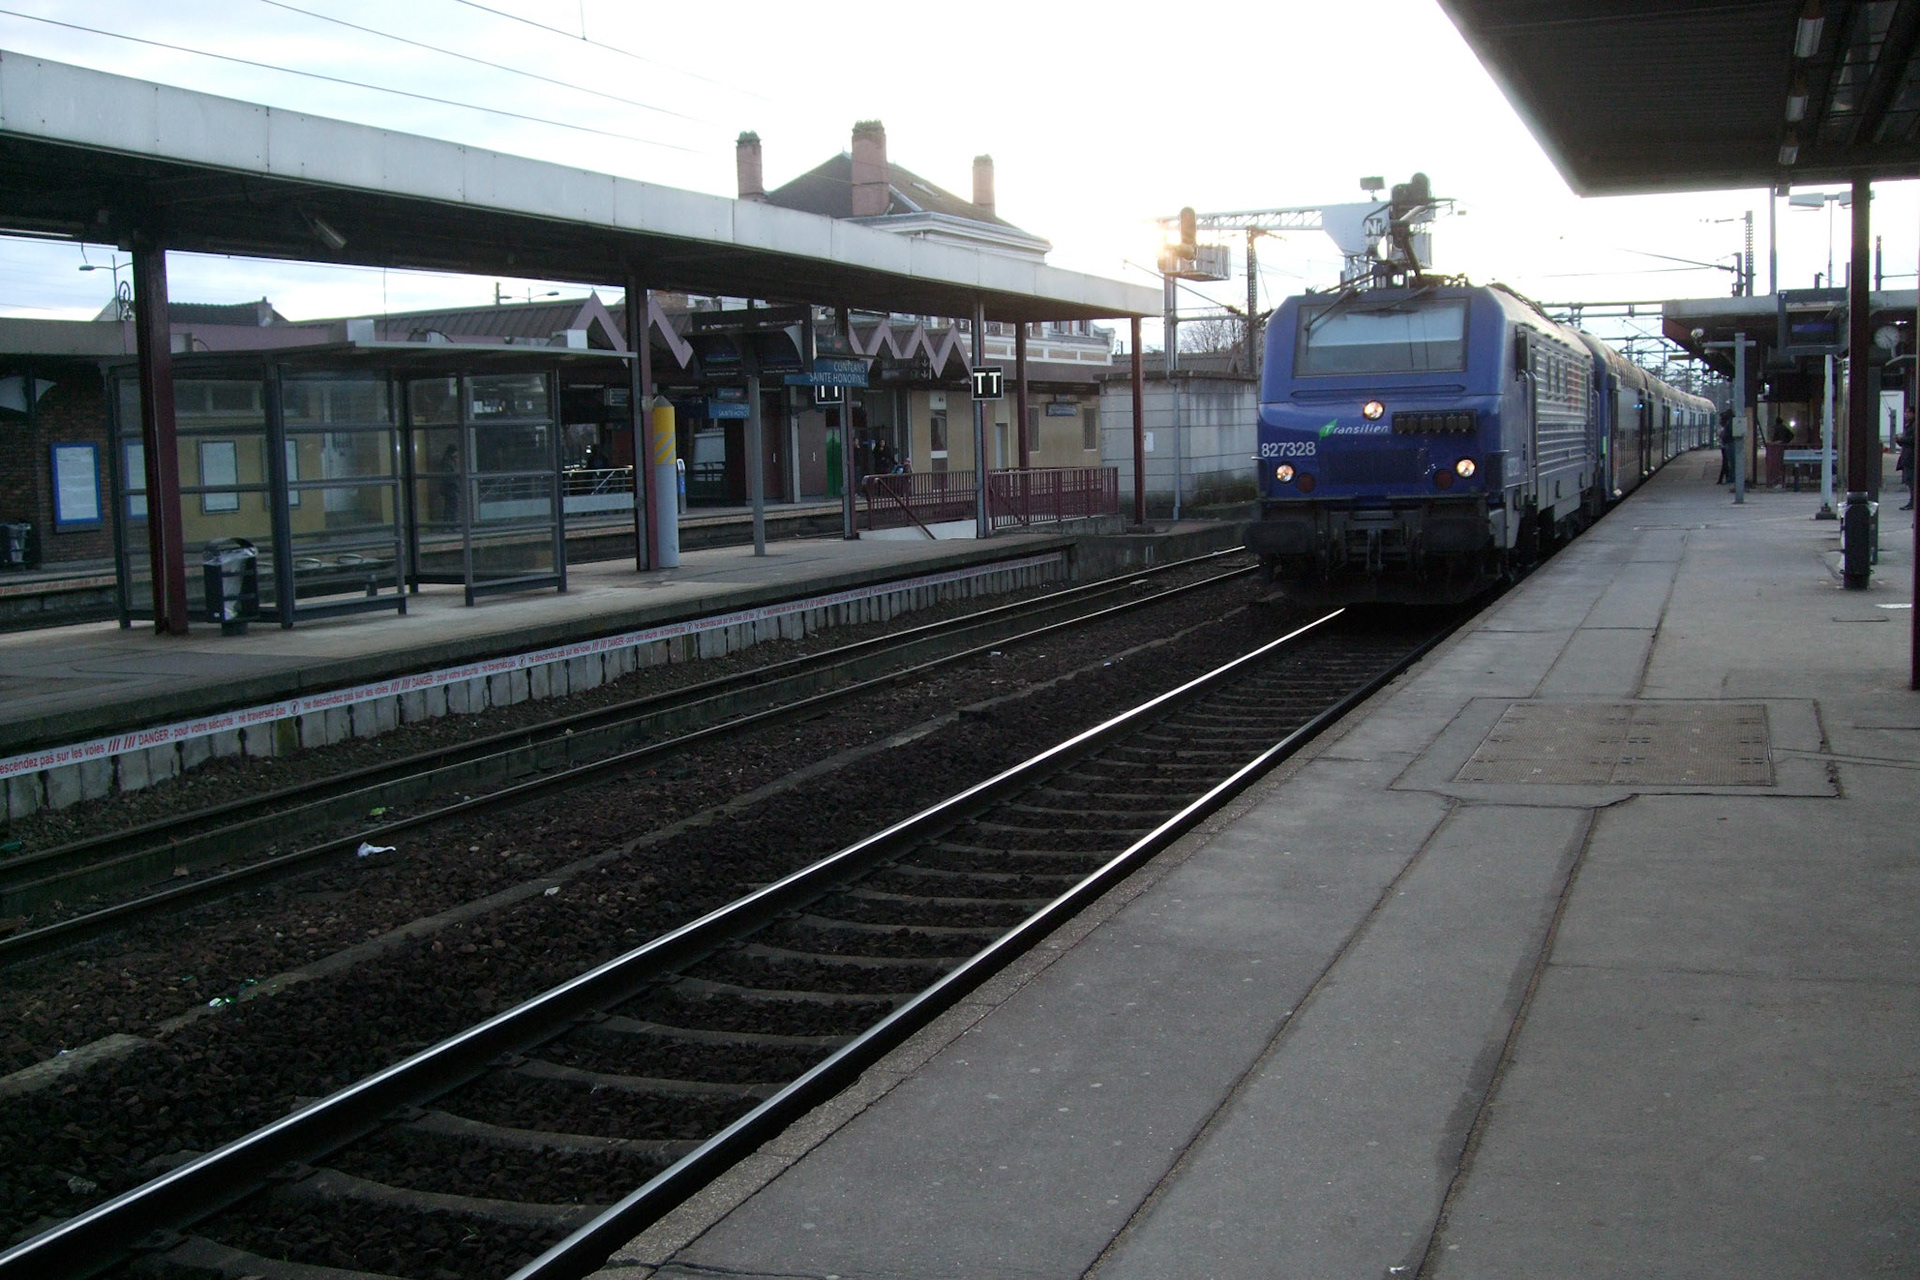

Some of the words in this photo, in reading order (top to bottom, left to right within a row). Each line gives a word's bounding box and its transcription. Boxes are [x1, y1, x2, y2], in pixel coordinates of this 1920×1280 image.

[973, 372, 1001, 394] TT
[1325, 424, 1389, 435] Transilien
[1261, 441, 1316, 457] 827328
[0, 757, 38, 774] escendez
[40, 753, 55, 768] pas
[56, 751, 70, 763] sur
[71, 747, 83, 759] les
[85, 743, 105, 756] voies
[138, 728, 169, 746] DANGER
[174, 725, 189, 740] pour
[190, 721, 207, 734] votre
